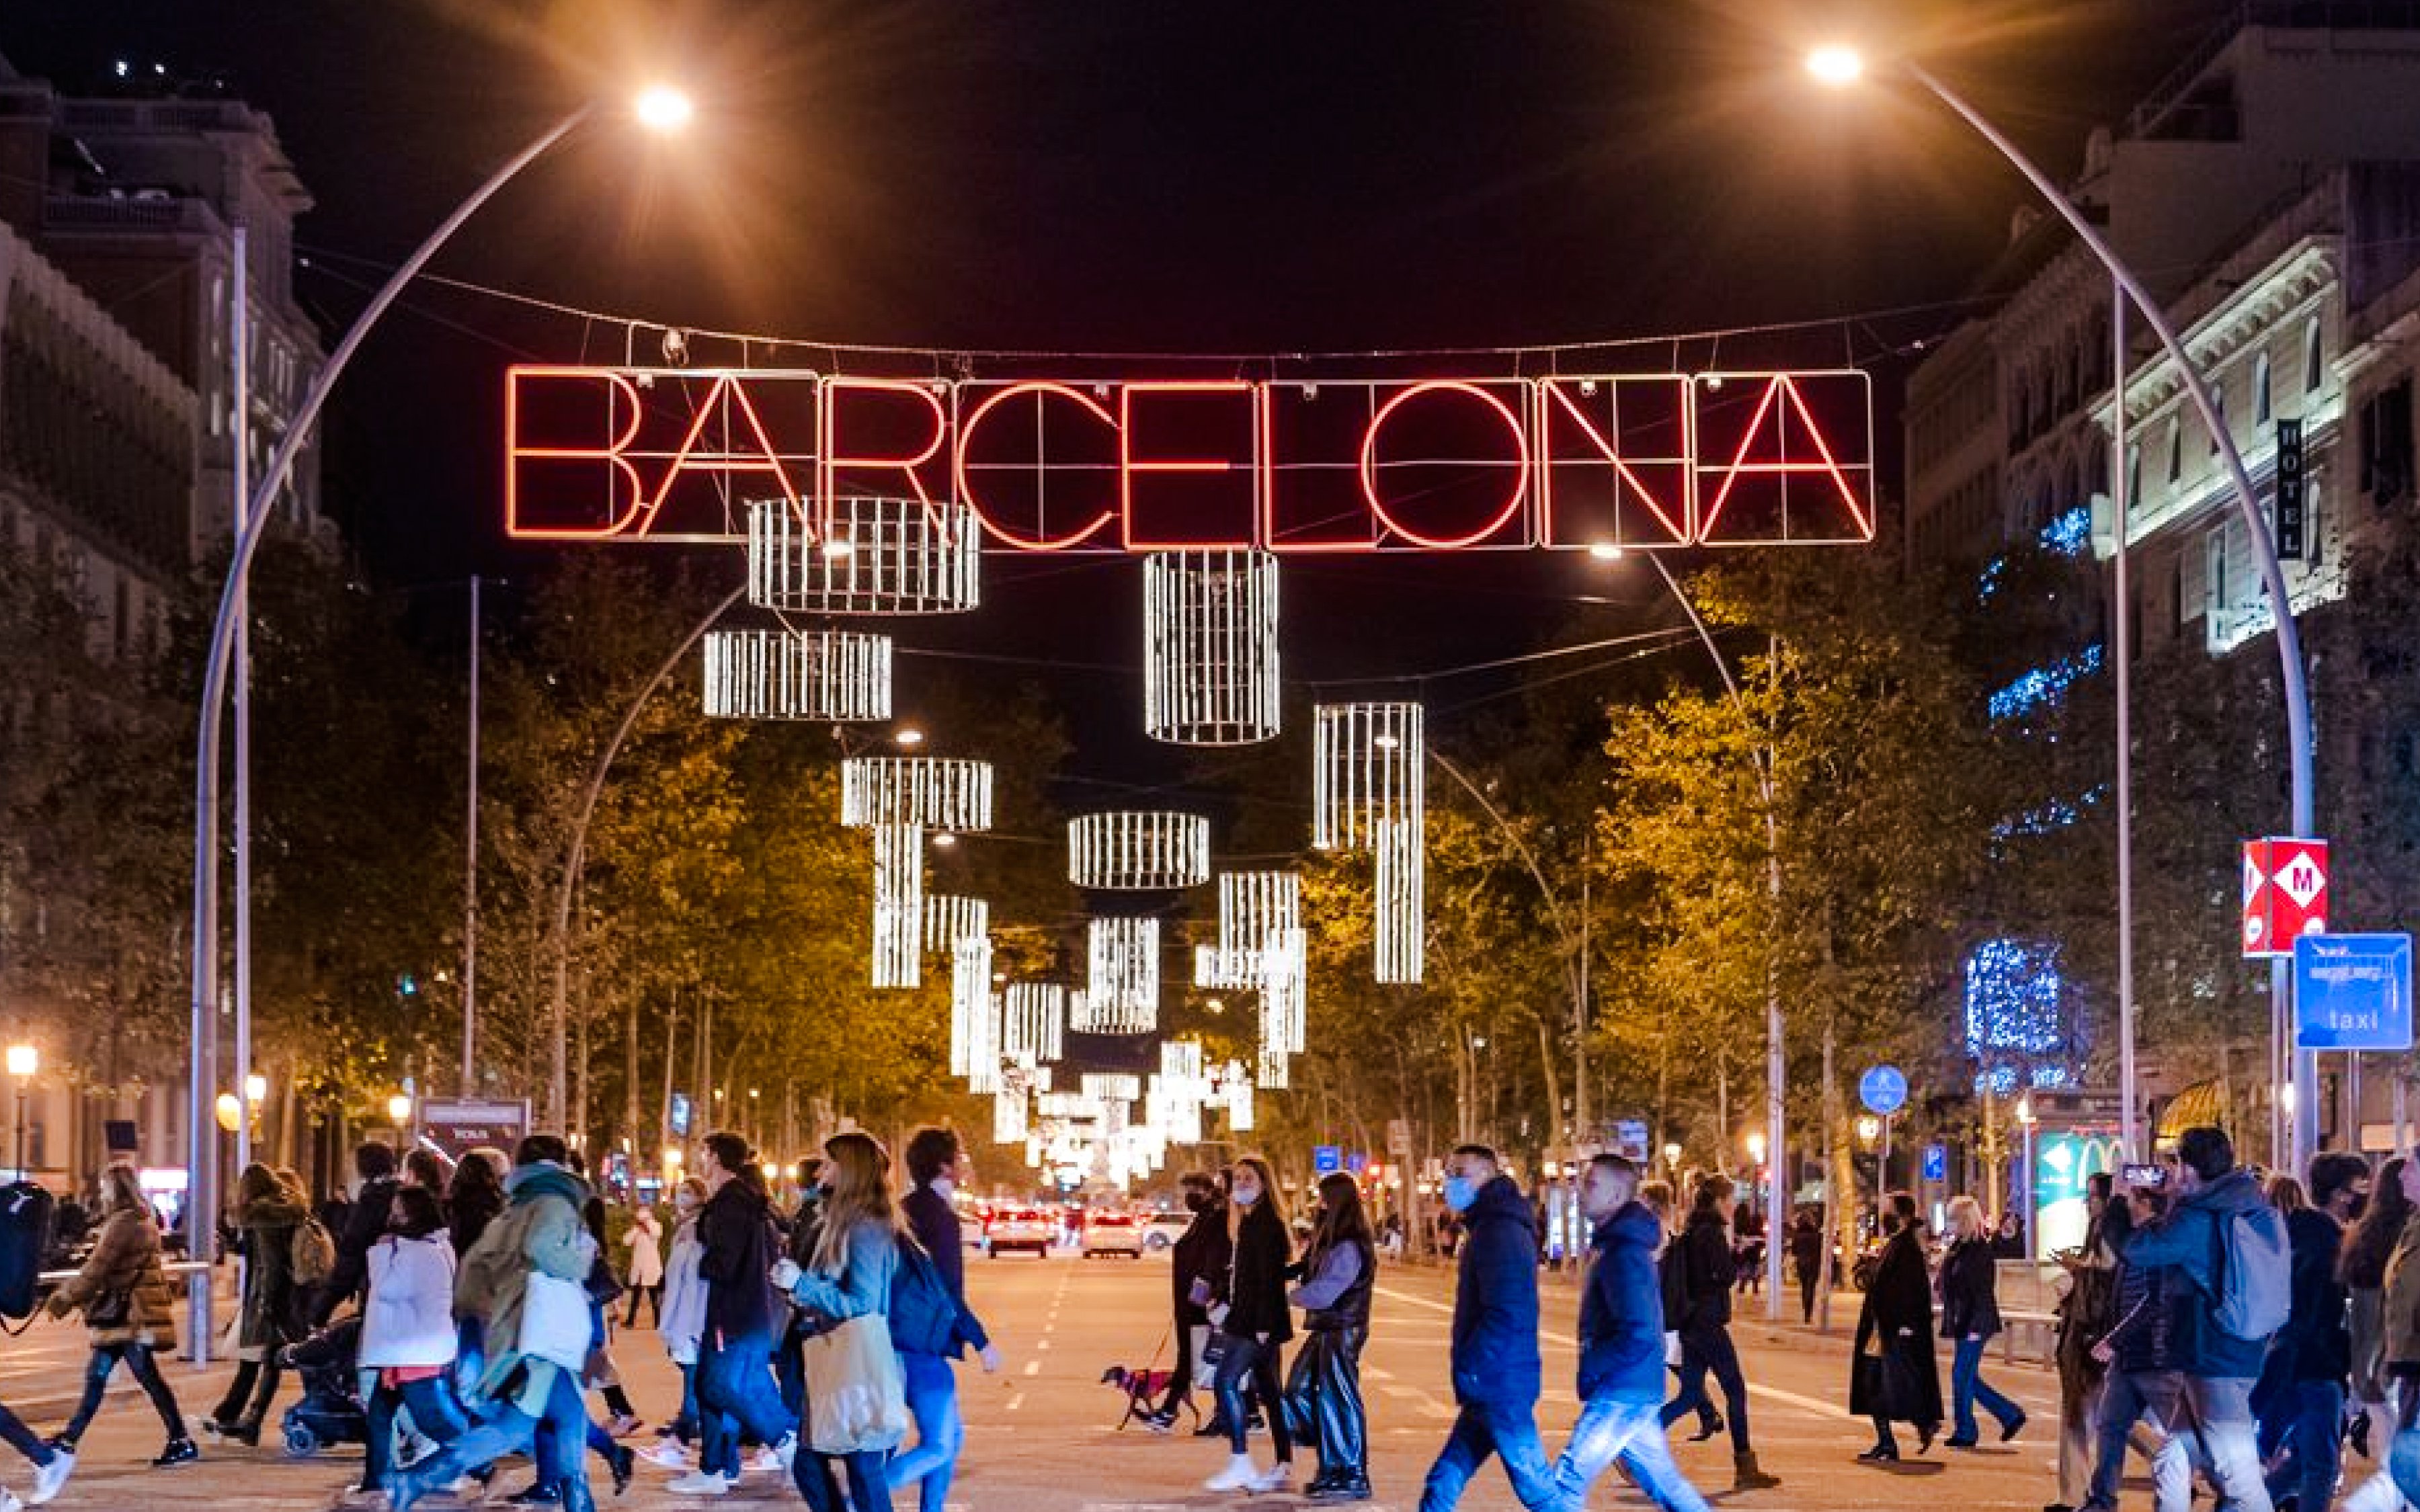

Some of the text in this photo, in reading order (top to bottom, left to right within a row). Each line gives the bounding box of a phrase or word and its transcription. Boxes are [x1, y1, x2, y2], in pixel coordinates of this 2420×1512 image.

[506, 366, 1876, 552] BARCELONA
[2282, 428, 2300, 551] HOTEL
[2292, 867, 2314, 892] M
[2330, 1009, 2378, 1030] taxi
